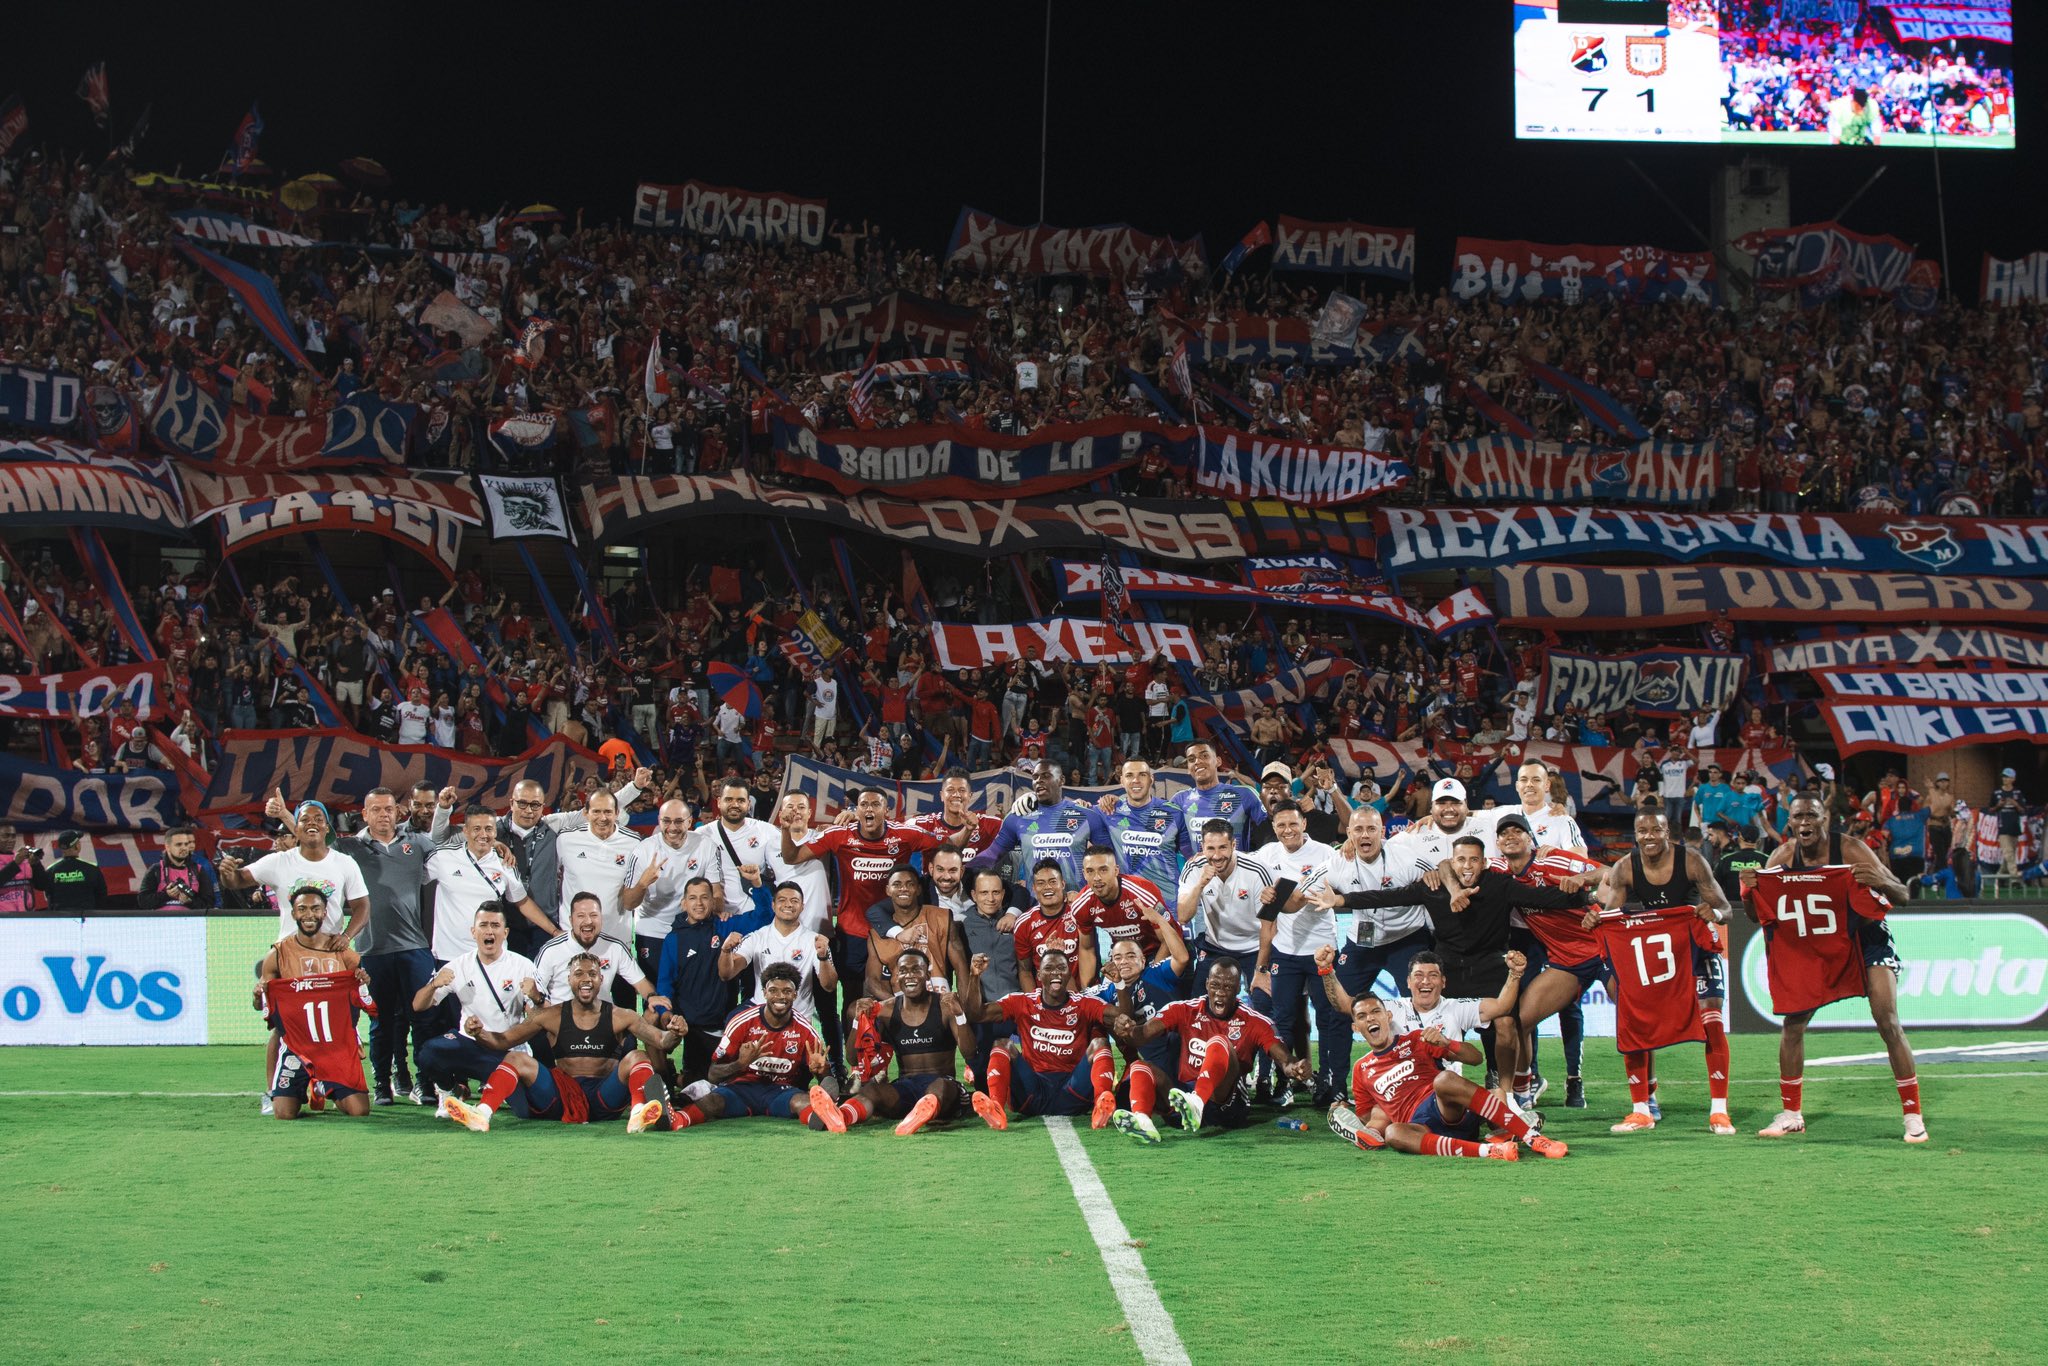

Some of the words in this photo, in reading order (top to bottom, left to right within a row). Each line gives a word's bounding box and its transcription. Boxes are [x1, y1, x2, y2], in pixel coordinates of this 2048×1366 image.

[1582, 88, 1608, 111] 7
[1636, 89, 1654, 112] 1
[633, 185, 675, 227] EL
[680, 184, 825, 246] ROXARIO
[1274, 225, 1415, 274] XAMORA
[837, 441, 952, 481] BANDA
[977, 450, 1021, 481] DE
[1048, 437, 1092, 470] LA
[1446, 437, 1591, 498] XANTA
[1627, 441, 1716, 498] ANA
[222, 491, 323, 546] LA
[1384, 506, 1865, 567] REXIXTENXIA
[1496, 563, 1589, 618] YO
[1603, 566, 1705, 615] TE
[1720, 566, 2034, 613] QUIERO
[1773, 635, 1896, 672] MOYA
[1824, 672, 1893, 696] LA
[1033, 834, 1072, 845] Colanta
[1033, 848, 1071, 860] Wplay.co
[1122, 832, 1162, 845] Colanta
[853, 859, 893, 869] Colanta
[854, 871, 889, 881] Wplay.c
[1778, 894, 1837, 937] 45
[1631, 933, 1677, 986] 13
[43, 956, 183, 1022] Vos
[295, 980, 315, 992] JFK
[303, 1001, 333, 1042] 11
[1032, 1027, 1073, 1041] Colanta
[901, 1037, 934, 1046] CATAPULT
[1033, 1041, 1073, 1055] Wplay.co
